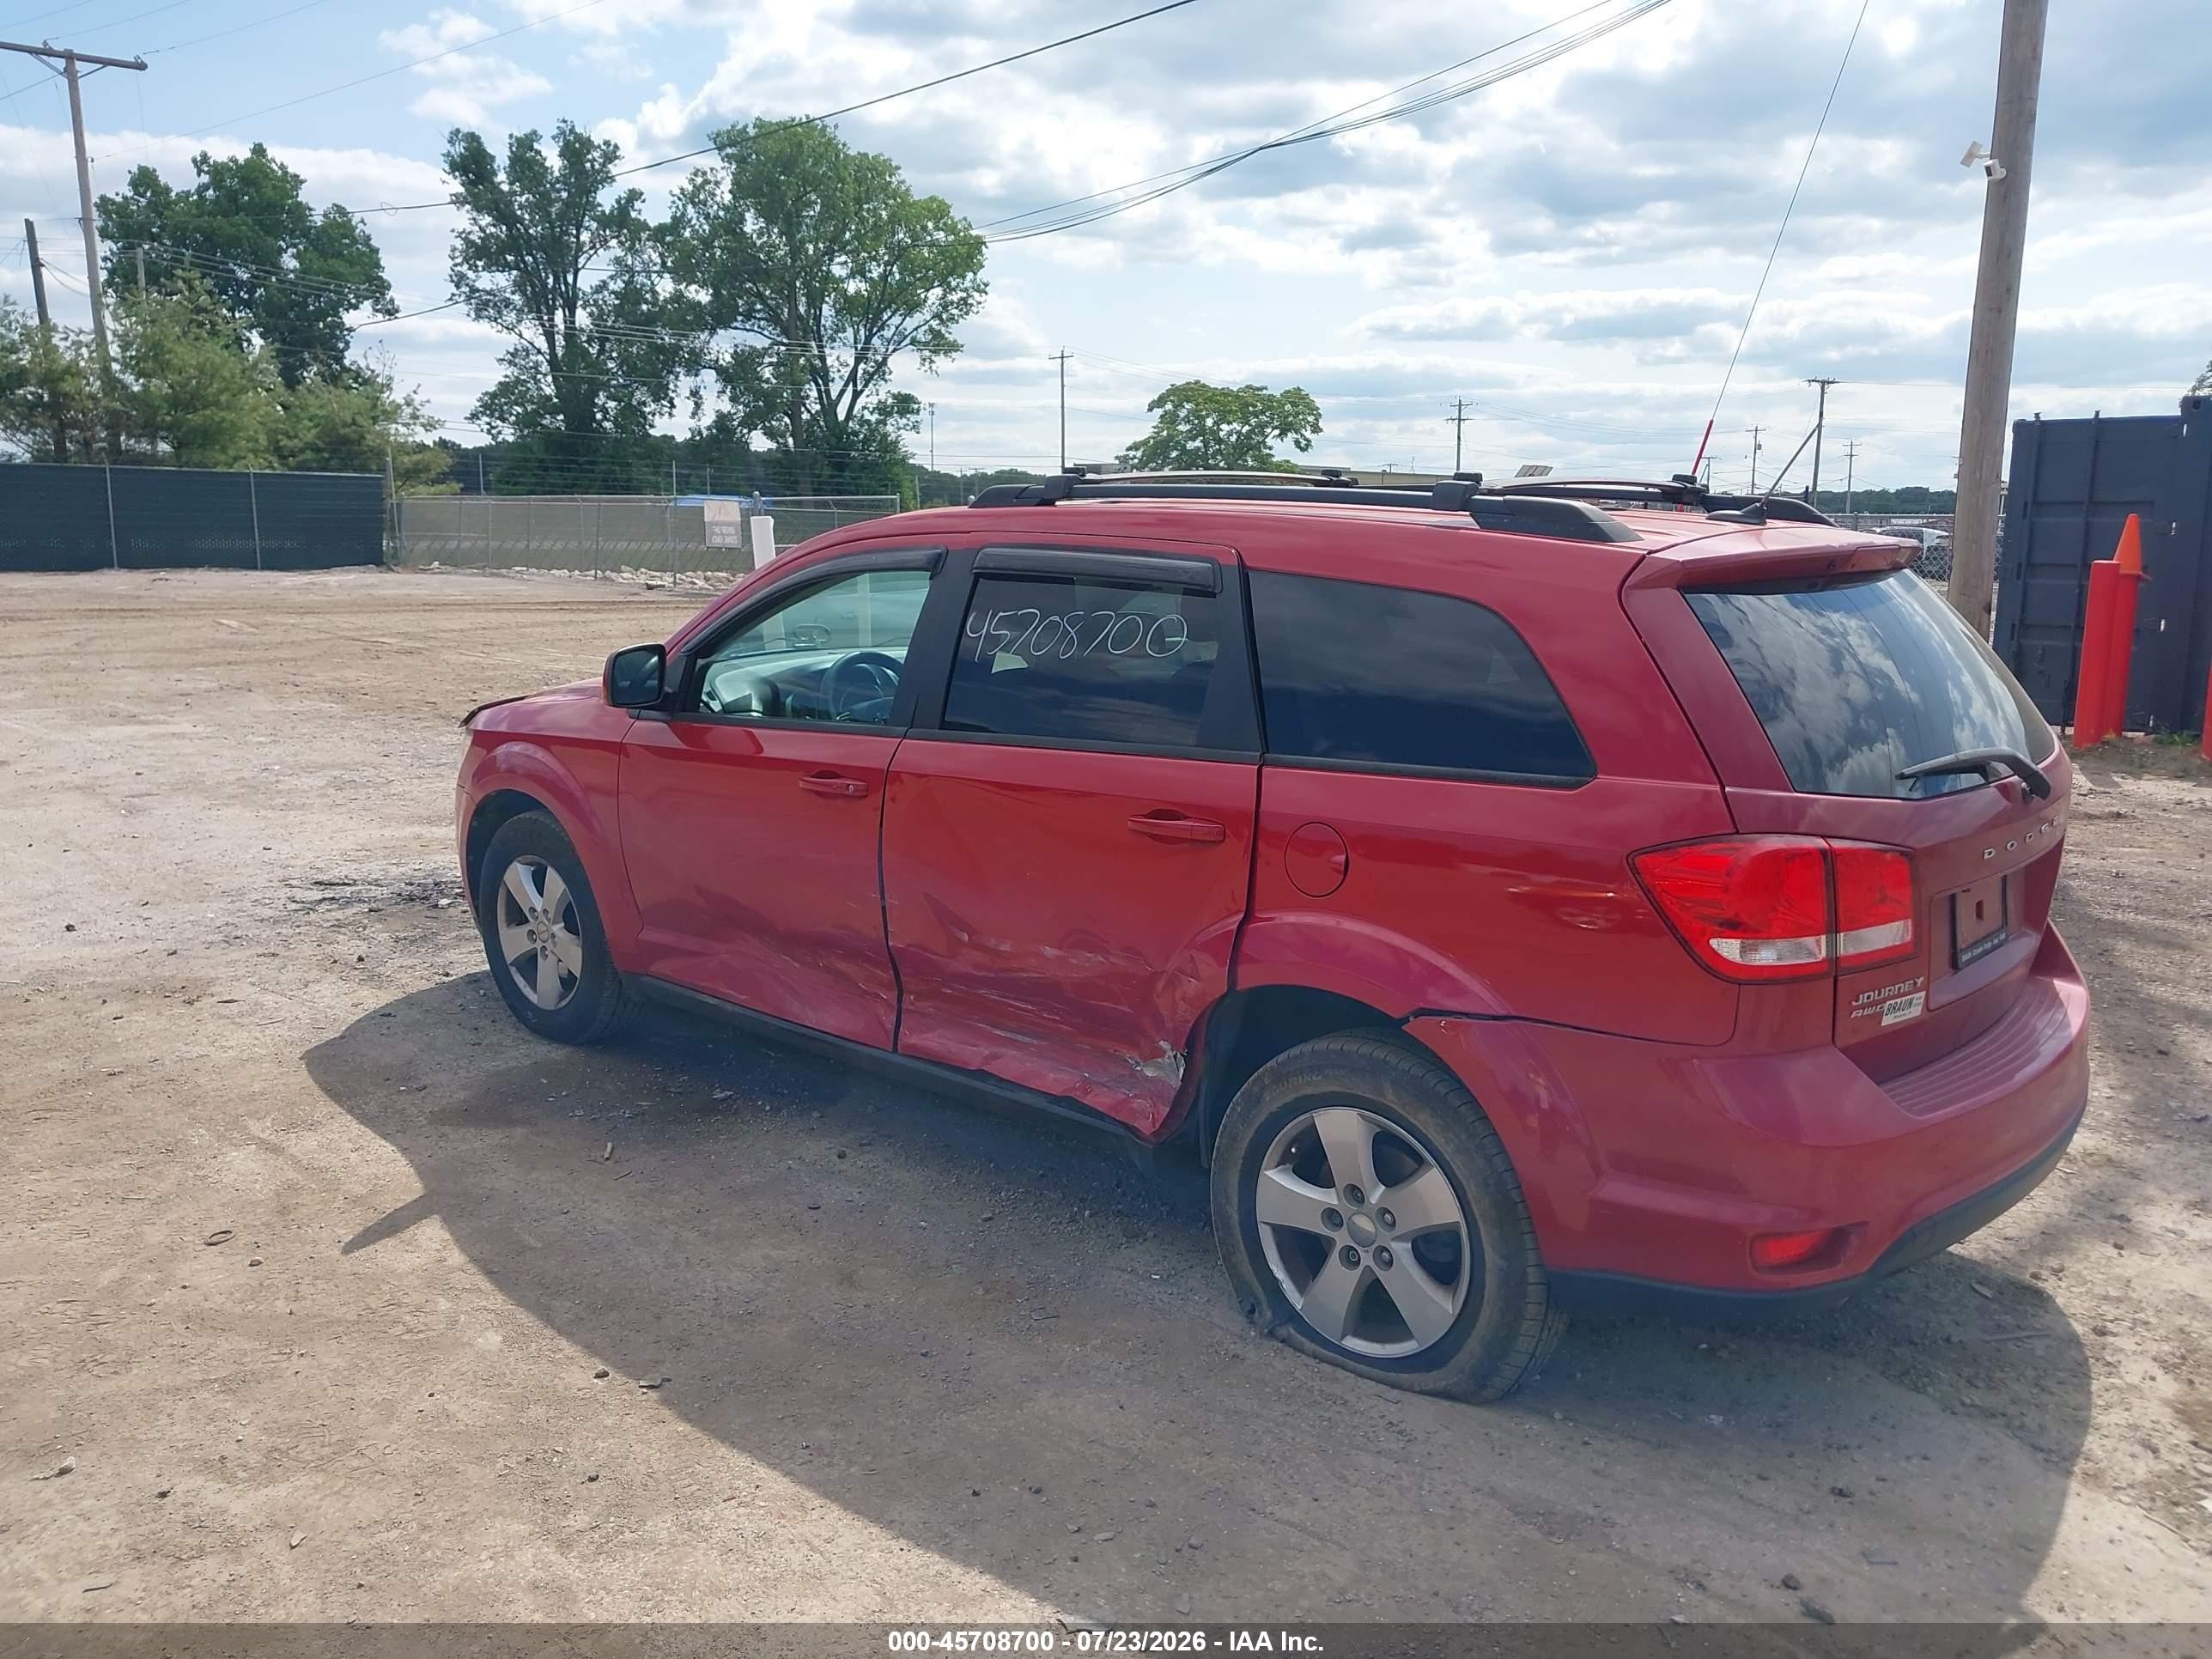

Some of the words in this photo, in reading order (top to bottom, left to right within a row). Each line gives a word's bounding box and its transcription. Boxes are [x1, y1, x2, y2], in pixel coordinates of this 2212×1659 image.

[966, 608, 1188, 662] 45708700
[1983, 816, 2060, 859] DODGE
[1850, 975, 1924, 1006] JOURNEY
[1885, 996, 1915, 1016] BRAUN
